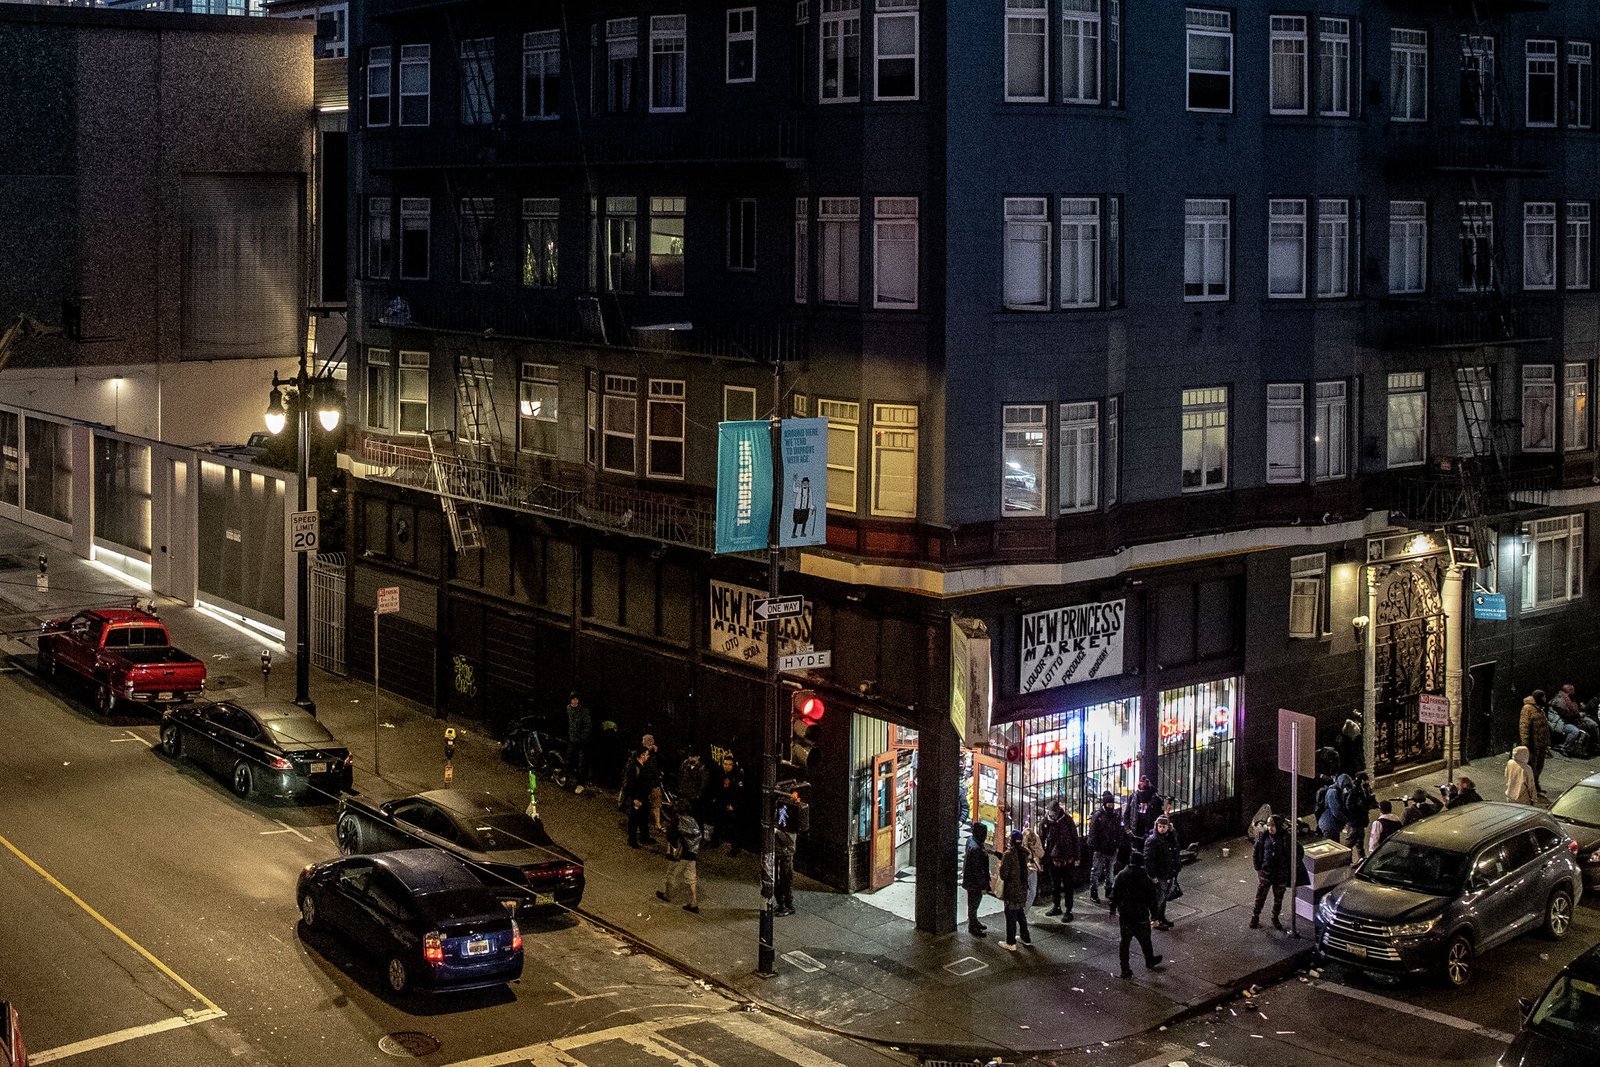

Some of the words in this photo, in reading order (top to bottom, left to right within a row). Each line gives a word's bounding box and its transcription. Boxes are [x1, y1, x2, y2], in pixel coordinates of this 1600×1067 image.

[784, 429, 804, 437] AROUND
[805, 428, 818, 436] HERE
[784, 438, 793, 446] WE
[794, 437, 806, 446] TEND
[786, 447, 793, 455] TO
[794, 446, 814, 454] IMPROVE
[787, 456, 800, 464] WITH
[737, 440, 752, 526] TENDERLOIN
[293, 515, 317, 524] SPEED
[295, 532, 316, 547] 20
[711, 585, 743, 625] NEW
[768, 604, 781, 613] ONE
[784, 602, 798, 611] WAY
[714, 619, 789, 650] MARKT
[1023, 612, 1058, 649] NEW
[1061, 602, 1123, 640] PRINCESS
[722, 637, 739, 652] LOTO
[743, 644, 760, 660] SODA
[1023, 632, 1116, 661] MARKET
[785, 654, 825, 668] HYDE
[1041, 656, 1063, 687] LOTTO
[1061, 650, 1087, 684] PRODUCE
[1088, 647, 1109, 678] GROCERY
[1023, 659, 1047, 692] LIQUOR
[1430, 697, 1448, 705] PARKING
